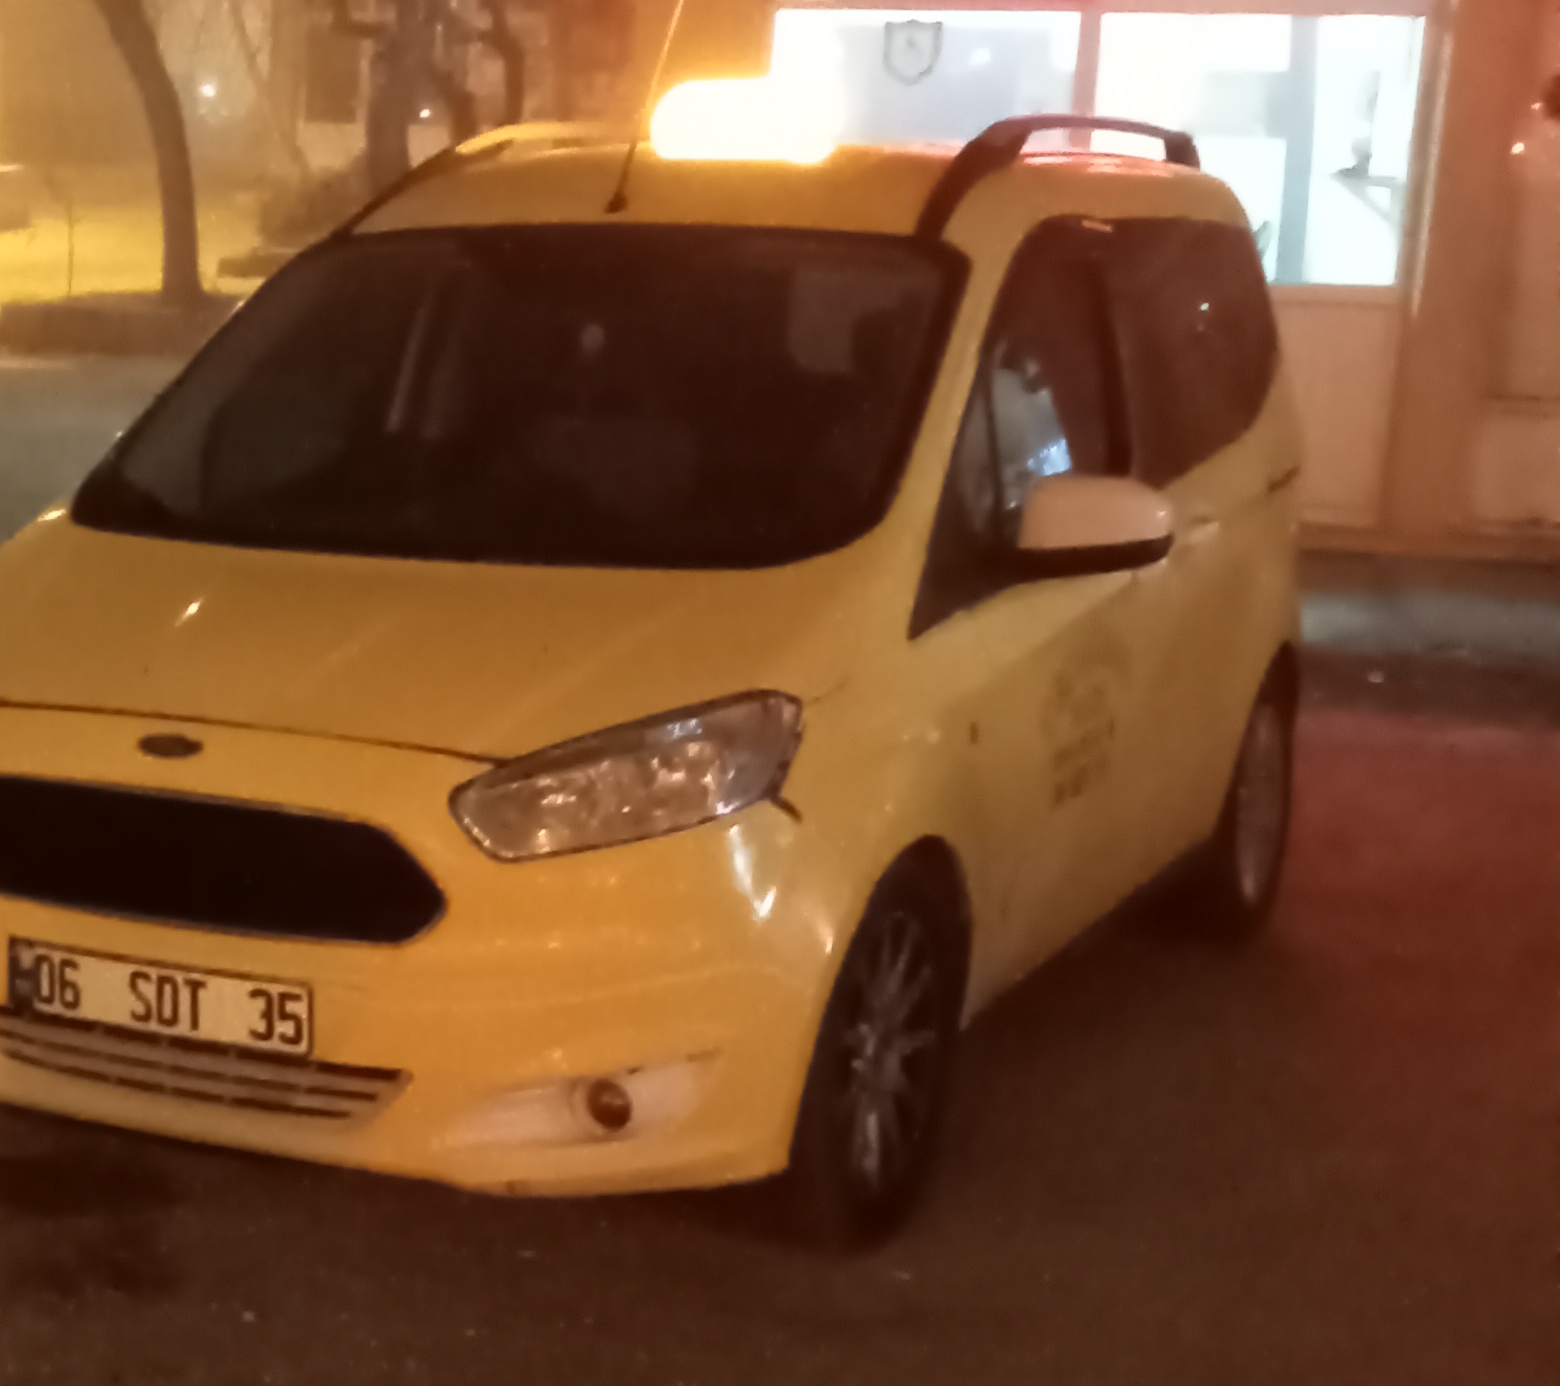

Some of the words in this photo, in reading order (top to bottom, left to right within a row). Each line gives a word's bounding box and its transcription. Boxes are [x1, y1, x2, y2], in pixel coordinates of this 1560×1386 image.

[35, 953, 81, 1010] 06
[128, 970, 207, 1032] SDT
[248, 987, 305, 1046] 35
